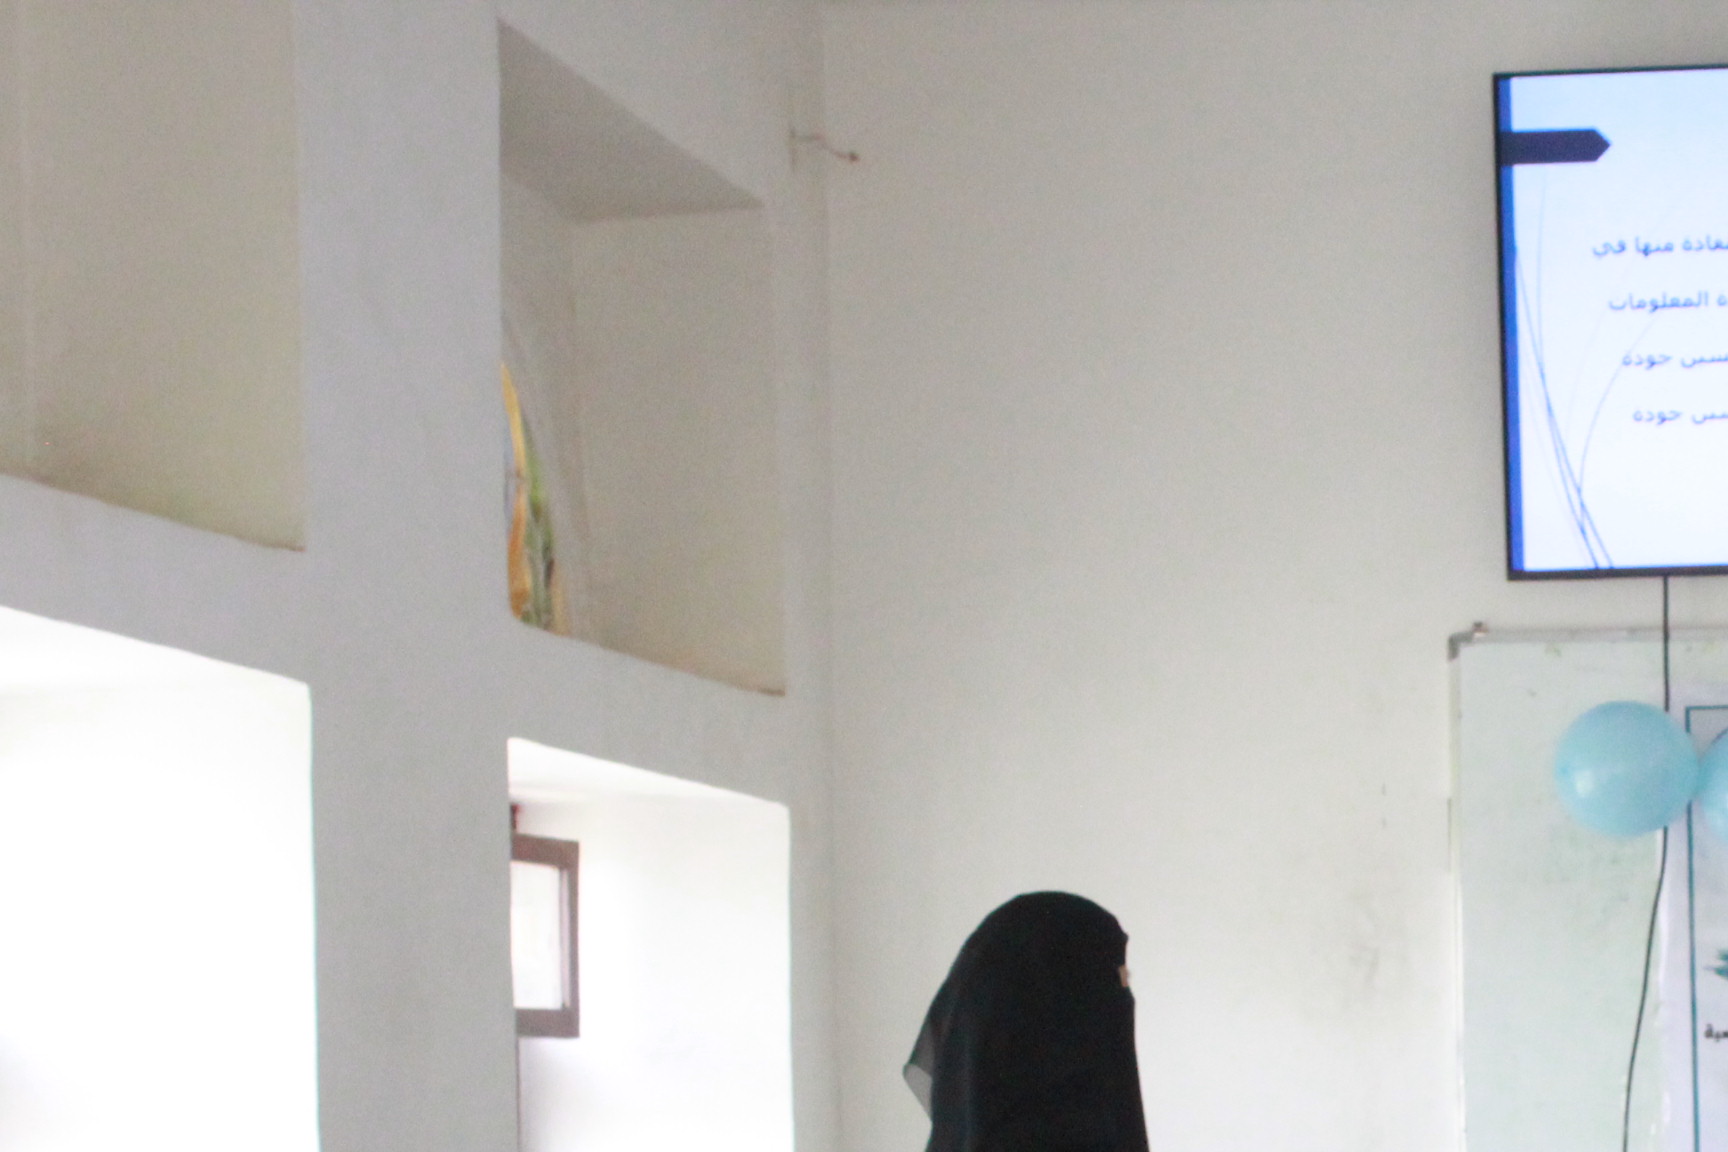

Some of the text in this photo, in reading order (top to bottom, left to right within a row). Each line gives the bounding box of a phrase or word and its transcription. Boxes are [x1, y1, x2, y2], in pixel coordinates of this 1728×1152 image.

[1634, 235, 1675, 258] منها
[1608, 290, 1709, 315] المعلومات
[1622, 352, 1673, 370] جودة
[1632, 407, 1683, 426] جودة
